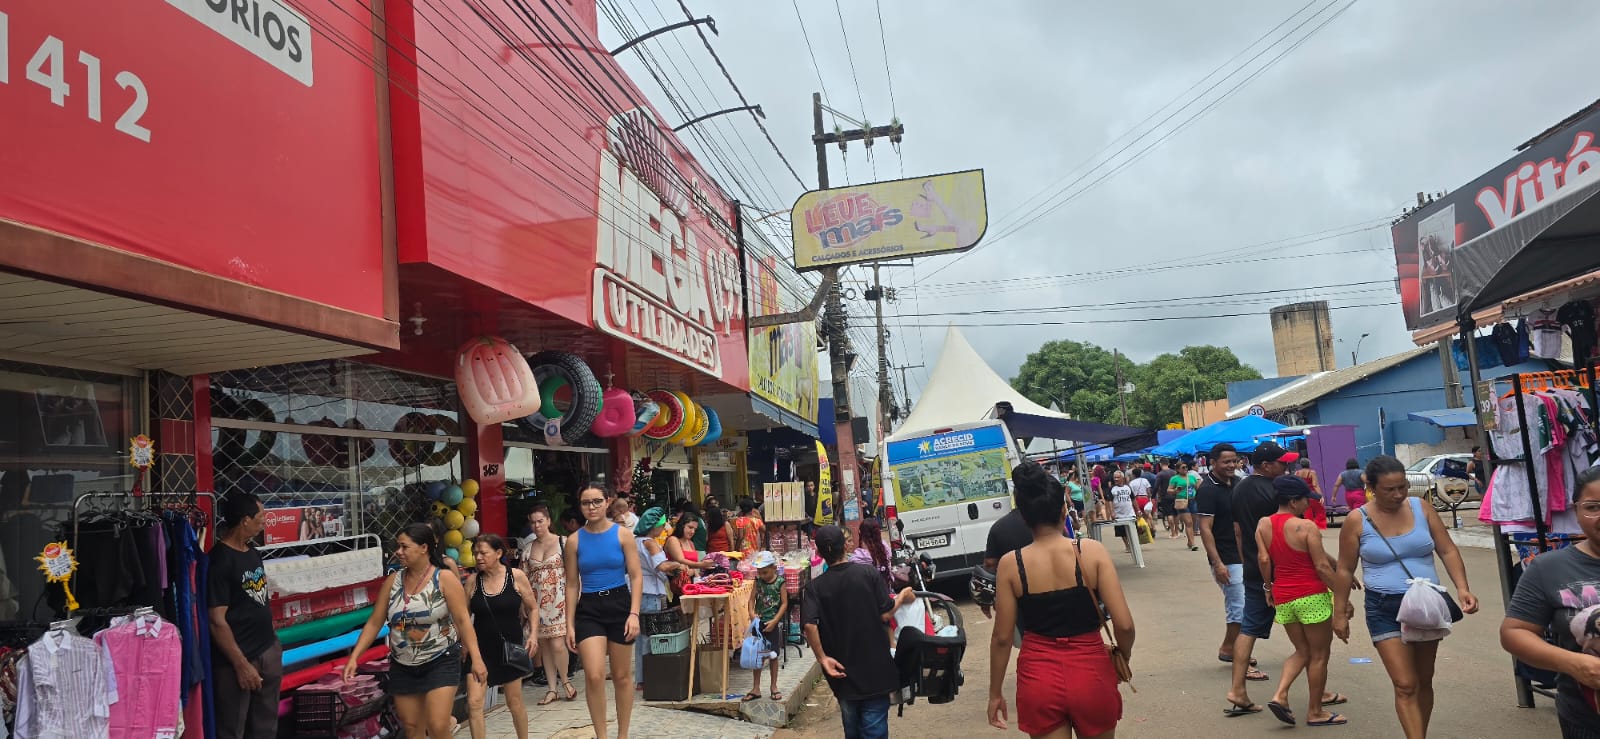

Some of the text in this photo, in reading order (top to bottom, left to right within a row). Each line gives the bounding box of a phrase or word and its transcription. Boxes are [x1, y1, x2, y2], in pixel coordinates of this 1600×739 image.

[804, 193, 873, 234] LEVE
[819, 206, 904, 249] mais
[596, 148, 714, 332] MEGA
[812, 250, 851, 262] CALÇADOS
[858, 244, 904, 257] ACESSÓRIOS
[608, 282, 715, 368] UTILIDADES
[1251, 408, 1263, 416] 30
